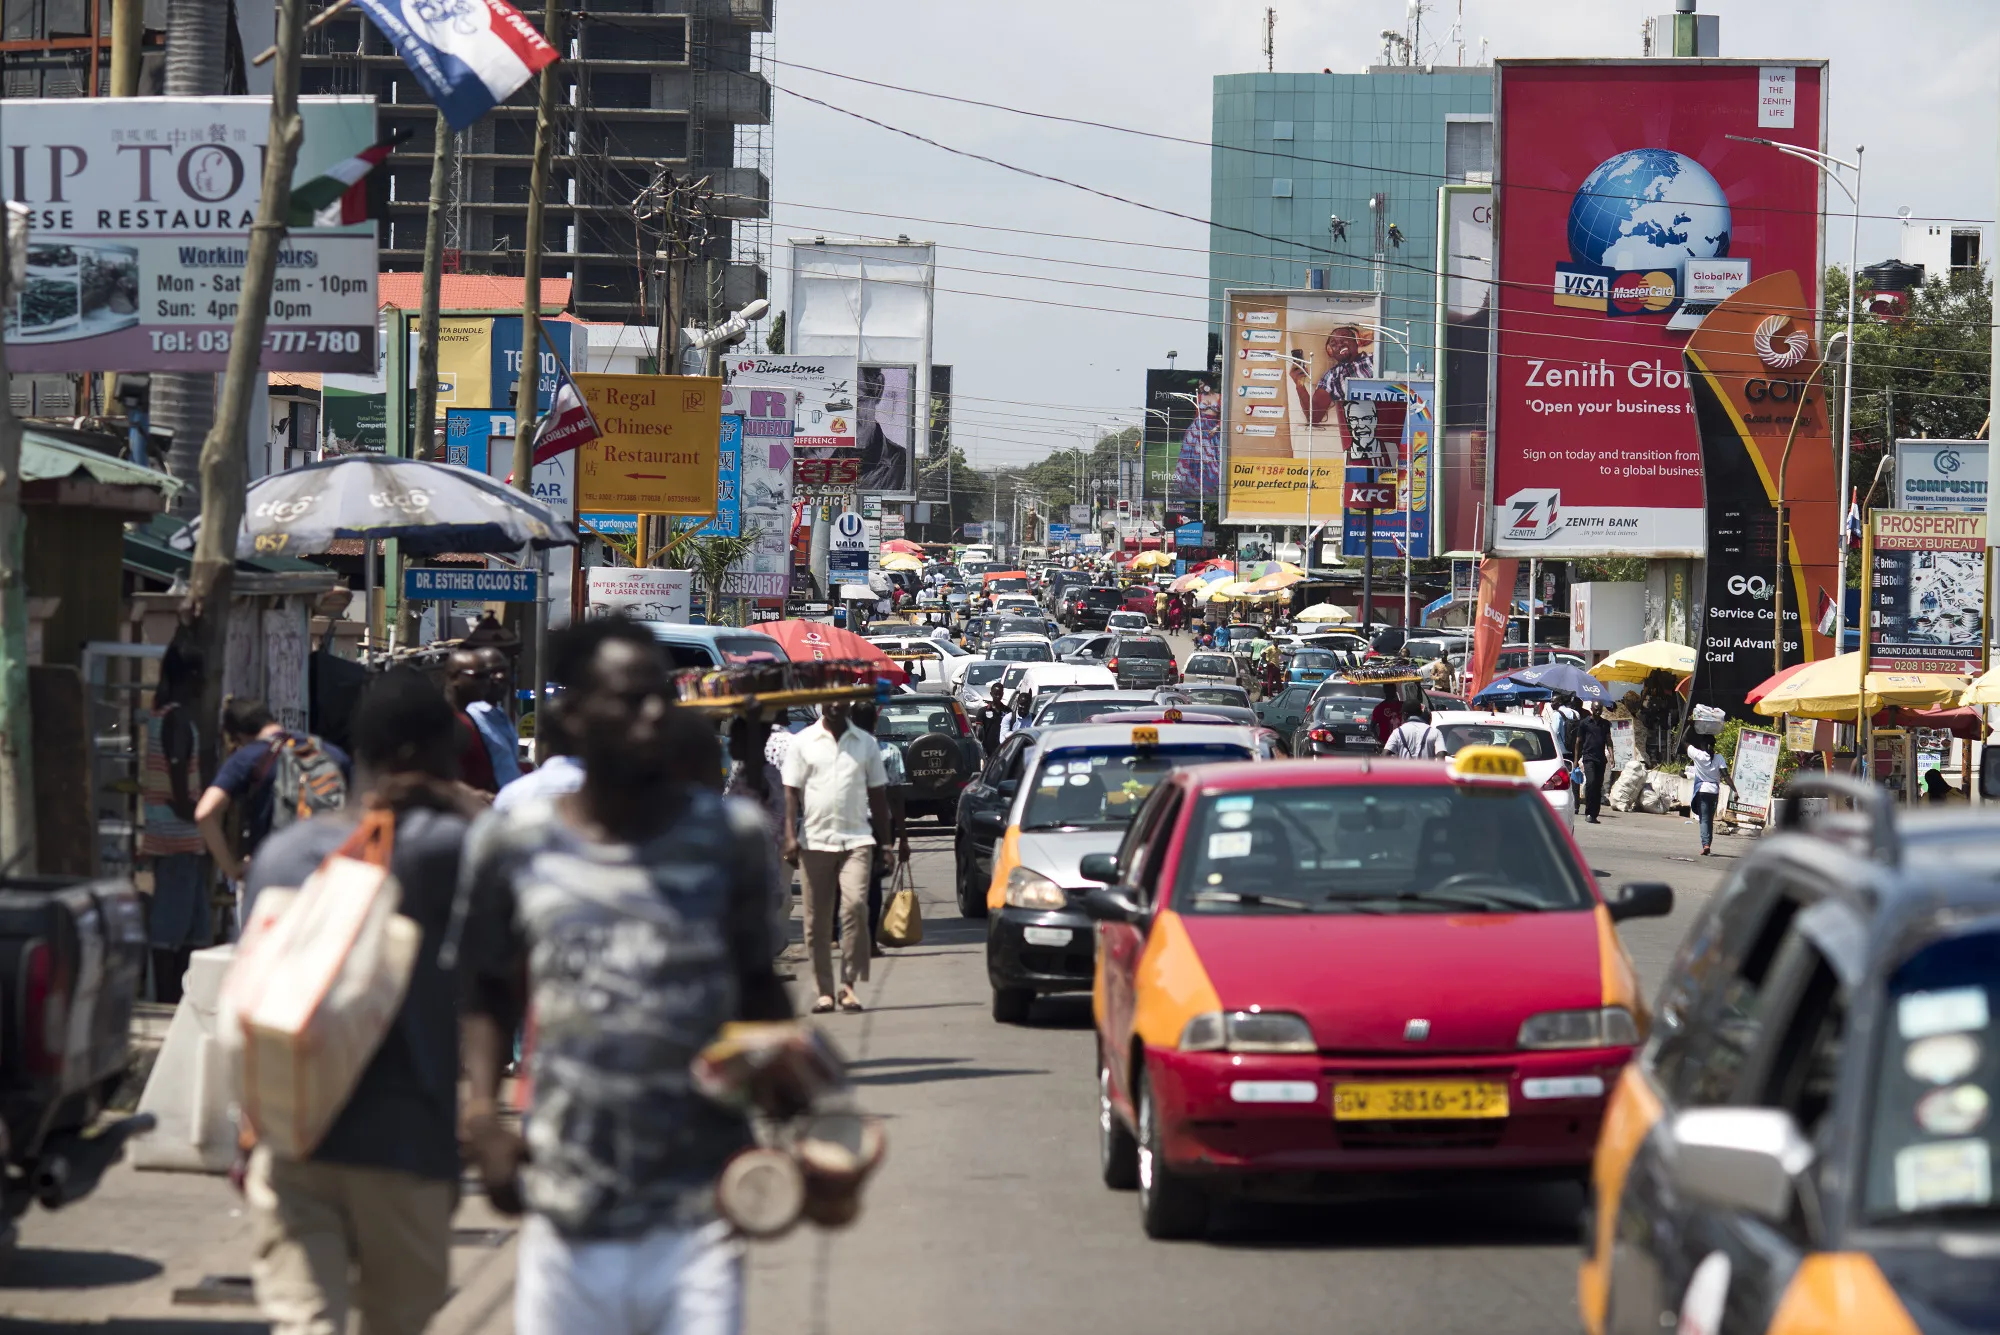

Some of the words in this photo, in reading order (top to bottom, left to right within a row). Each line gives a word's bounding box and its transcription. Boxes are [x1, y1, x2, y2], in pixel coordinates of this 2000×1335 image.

[1769, 75, 1786, 83] LIVE
[1769, 86, 1784, 94] THE
[1762, 97, 1792, 106] ZENITH
[1769, 109, 1785, 117] LIFE
[8, 145, 88, 203] IP
[116, 143, 268, 204] TO
[99, 209, 256, 230] RESTAURA
[178, 246, 248, 268] Workin
[275, 248, 318, 268] ours
[1693, 271, 1744, 281] GlobalPAY
[157, 274, 195, 293] Mon
[274, 279, 301, 293] am
[319, 275, 368, 297] 10pm
[1563, 275, 1605, 298] VISA
[1612, 284, 1674, 300] MasterCard
[157, 300, 196, 318] Sun:
[149, 330, 193, 353] Tel:
[503, 349, 557, 374] TENO
[756, 360, 825, 374] Binatone
[1525, 358, 1615, 388] Zenith
[606, 387, 656, 411] Regal
[1525, 399, 1573, 416] "Open
[1577, 402, 1612, 416] your
[1616, 399, 1681, 414] business
[1743, 414, 1772, 424] Good
[604, 417, 673, 436] Chinese
[540, 424, 576, 446] PATRIOT
[604, 445, 700, 465] Restaurant
[1523, 449, 1547, 462] Sign
[1565, 449, 1596, 462] today
[1598, 449, 1619, 460] and
[1621, 449, 1672, 461] transition
[1674, 450, 1700, 461] from
[1151, 470, 1181, 481] Printex
[1234, 464, 1254, 475] Dial
[1287, 466, 1314, 478] today
[1316, 468, 1330, 477] for
[1600, 466, 1611, 475] to
[1623, 465, 1656, 478] global
[821, 484, 855, 493] SLOTS
[1233, 480, 1255, 489] your
[1257, 479, 1292, 490] perfect
[369, 488, 430, 515] tigo
[809, 496, 848, 507] OFFICE
[1349, 488, 1390, 503] KFC
[255, 495, 312, 523] tigo
[599, 518, 638, 531] gordonyoun
[1565, 517, 1605, 527] ZENITH
[1608, 518, 1638, 528] BANK
[1881, 515, 1979, 535] PROSPERITY
[1509, 529, 1537, 537] ZENITH
[835, 538, 864, 548] union
[1880, 536, 1924, 549] FOREX
[1927, 538, 1978, 550] BUREAU
[1880, 558, 1898, 569] British
[416, 572, 433, 589] DR.
[435, 573, 475, 590] ESTHER
[476, 573, 511, 591] OCLOO
[513, 574, 529, 591] ST.
[593, 581, 639, 589] INTER-STAR
[1727, 574, 1767, 596] GO
[1881, 575, 1889, 585] US
[614, 588, 639, 596] LASER
[640, 588, 671, 596] CENTRE
[1881, 594, 1894, 604] Euro
[762, 611, 780, 620] Bags
[1483, 603, 1506, 629] busy
[1710, 607, 1754, 620] Service
[1706, 636, 1731, 649] Goil
[1734, 637, 1798, 652] Advantge
[1705, 652, 1734, 663] Card
[1877, 646, 1901, 655] GROUND
[1922, 647, 1936, 656] BLUE
[1937, 648, 1955, 656] ROYAL
[1956, 648, 1974, 657] HOTEL
[1894, 661, 1918, 671] 0208
[1920, 662, 1937, 672] 139
[1939, 662, 1957, 672] 722
[1582, 684, 1601, 697] tigo
[1164, 711, 1182, 720] TAXI
[1132, 730, 1158, 741] TAXI
[1472, 755, 1520, 775] TAXI
[912, 767, 958, 777] HONDA
